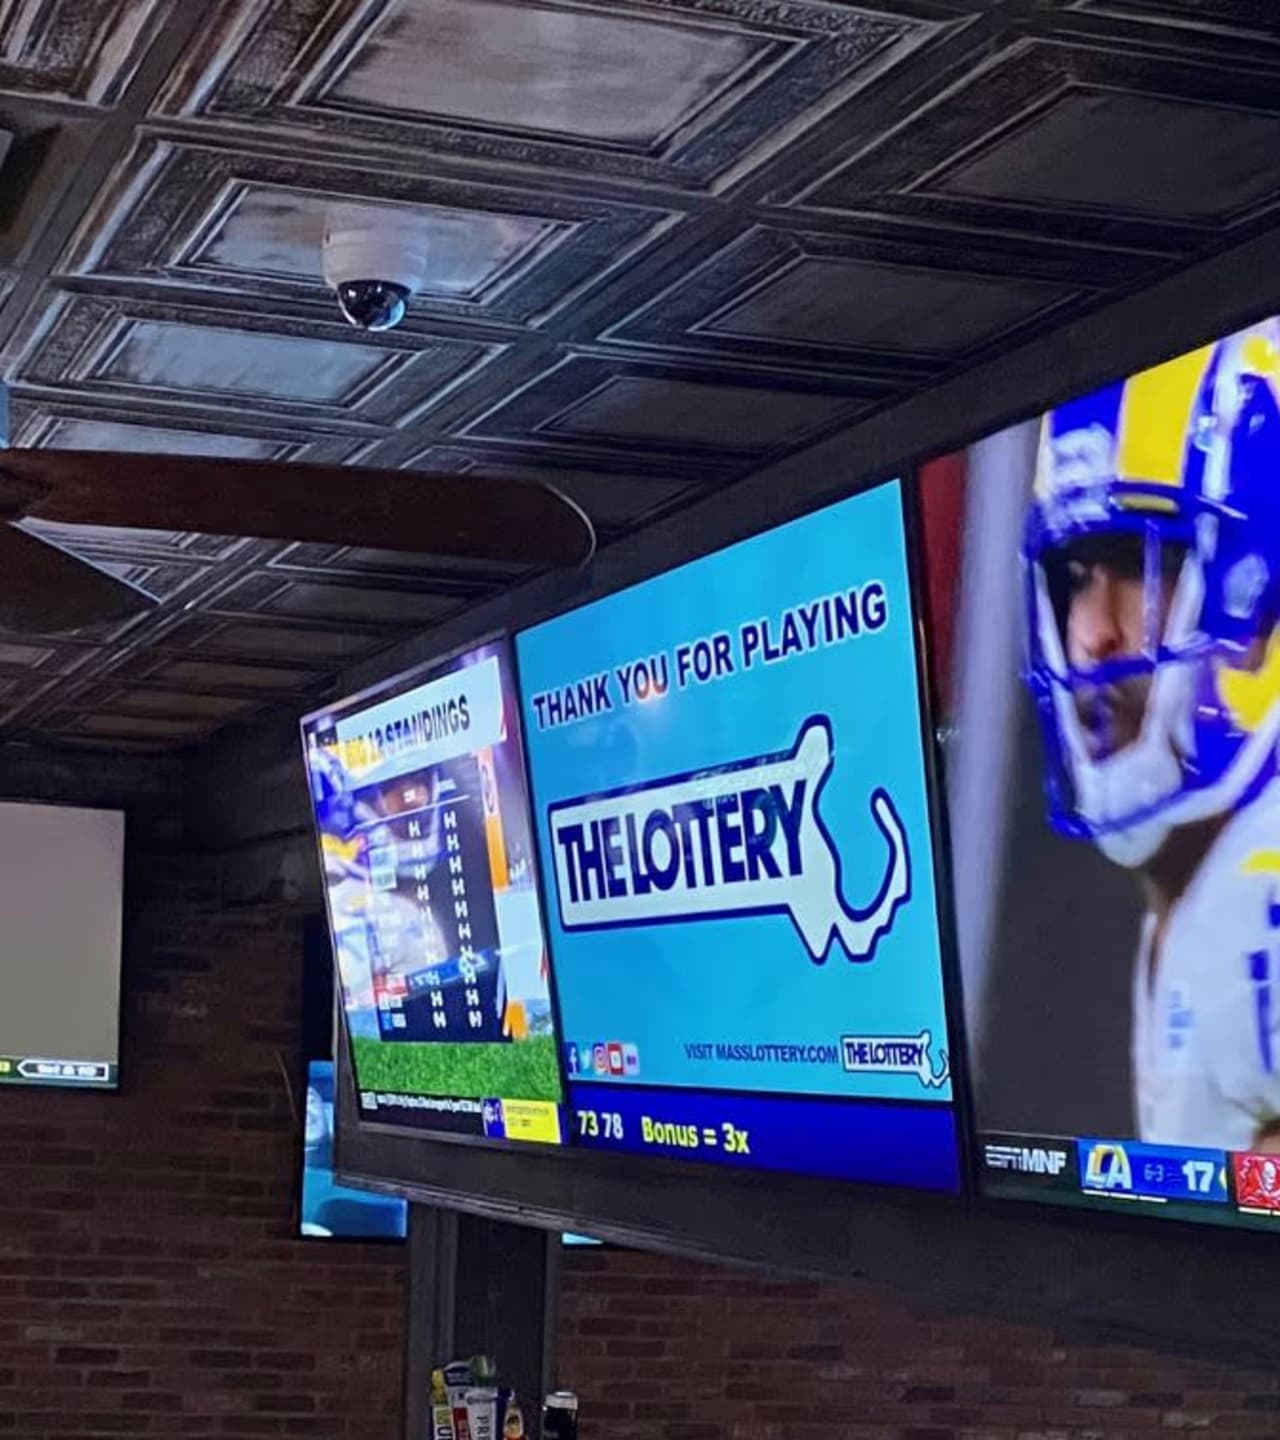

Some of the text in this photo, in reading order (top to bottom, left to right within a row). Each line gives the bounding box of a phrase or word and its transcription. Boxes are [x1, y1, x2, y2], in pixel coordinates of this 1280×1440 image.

[533, 583, 888, 730] THANK YOU FOR PLAYING
[385, 694, 471, 747] STANDINGS
[558, 779, 808, 903] THE LOTTERY
[685, 1043, 839, 1065] VISIT MASSLOTTERY.COM
[845, 1042, 924, 1067] THE LOTTERY
[577, 1110, 599, 1137] 73
[601, 1112, 624, 1140] 78
[641, 1115, 699, 1148] Bonus
[722, 1122, 751, 1154] 3x
[1083, 1144, 1133, 1190] LA
[1181, 1160, 1215, 1193] 17
